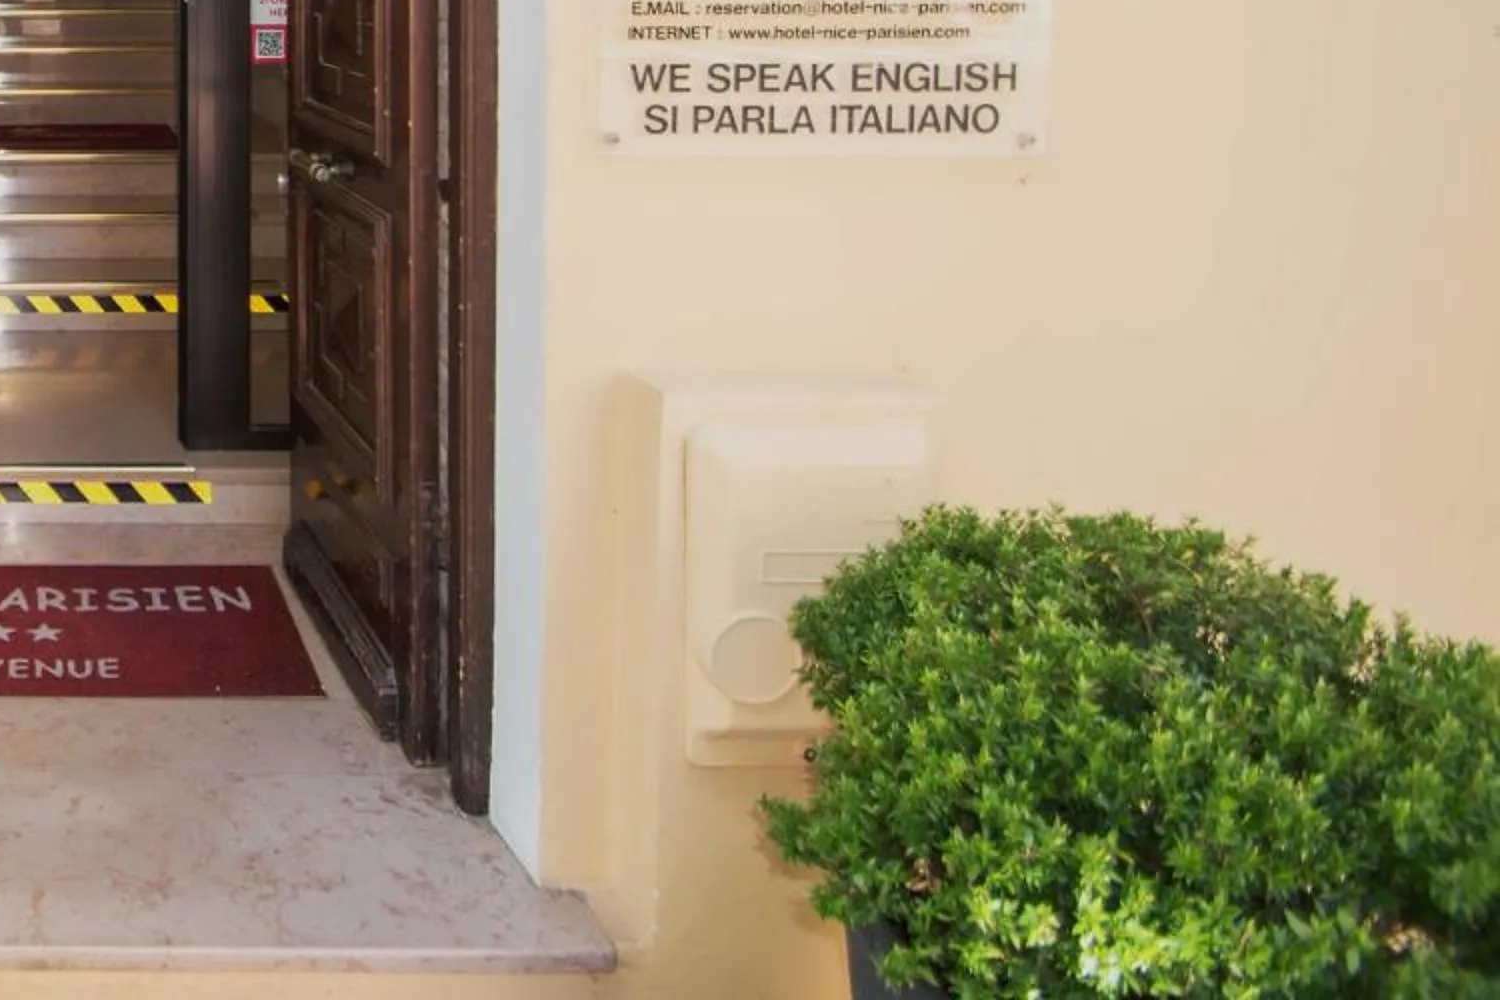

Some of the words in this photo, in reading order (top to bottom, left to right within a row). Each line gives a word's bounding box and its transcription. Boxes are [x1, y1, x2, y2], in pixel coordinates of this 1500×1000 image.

[628, 26, 710, 40] INTERNET
[728, 24, 970, 43] www.hotel-nice-parisien.com
[631, 64, 690, 93] WE
[706, 63, 835, 93] SPEAK
[851, 62, 1018, 93] ENGLISH
[644, 105, 677, 134] SI
[693, 105, 815, 134] PARLA
[830, 103, 999, 134] ITALIANO
